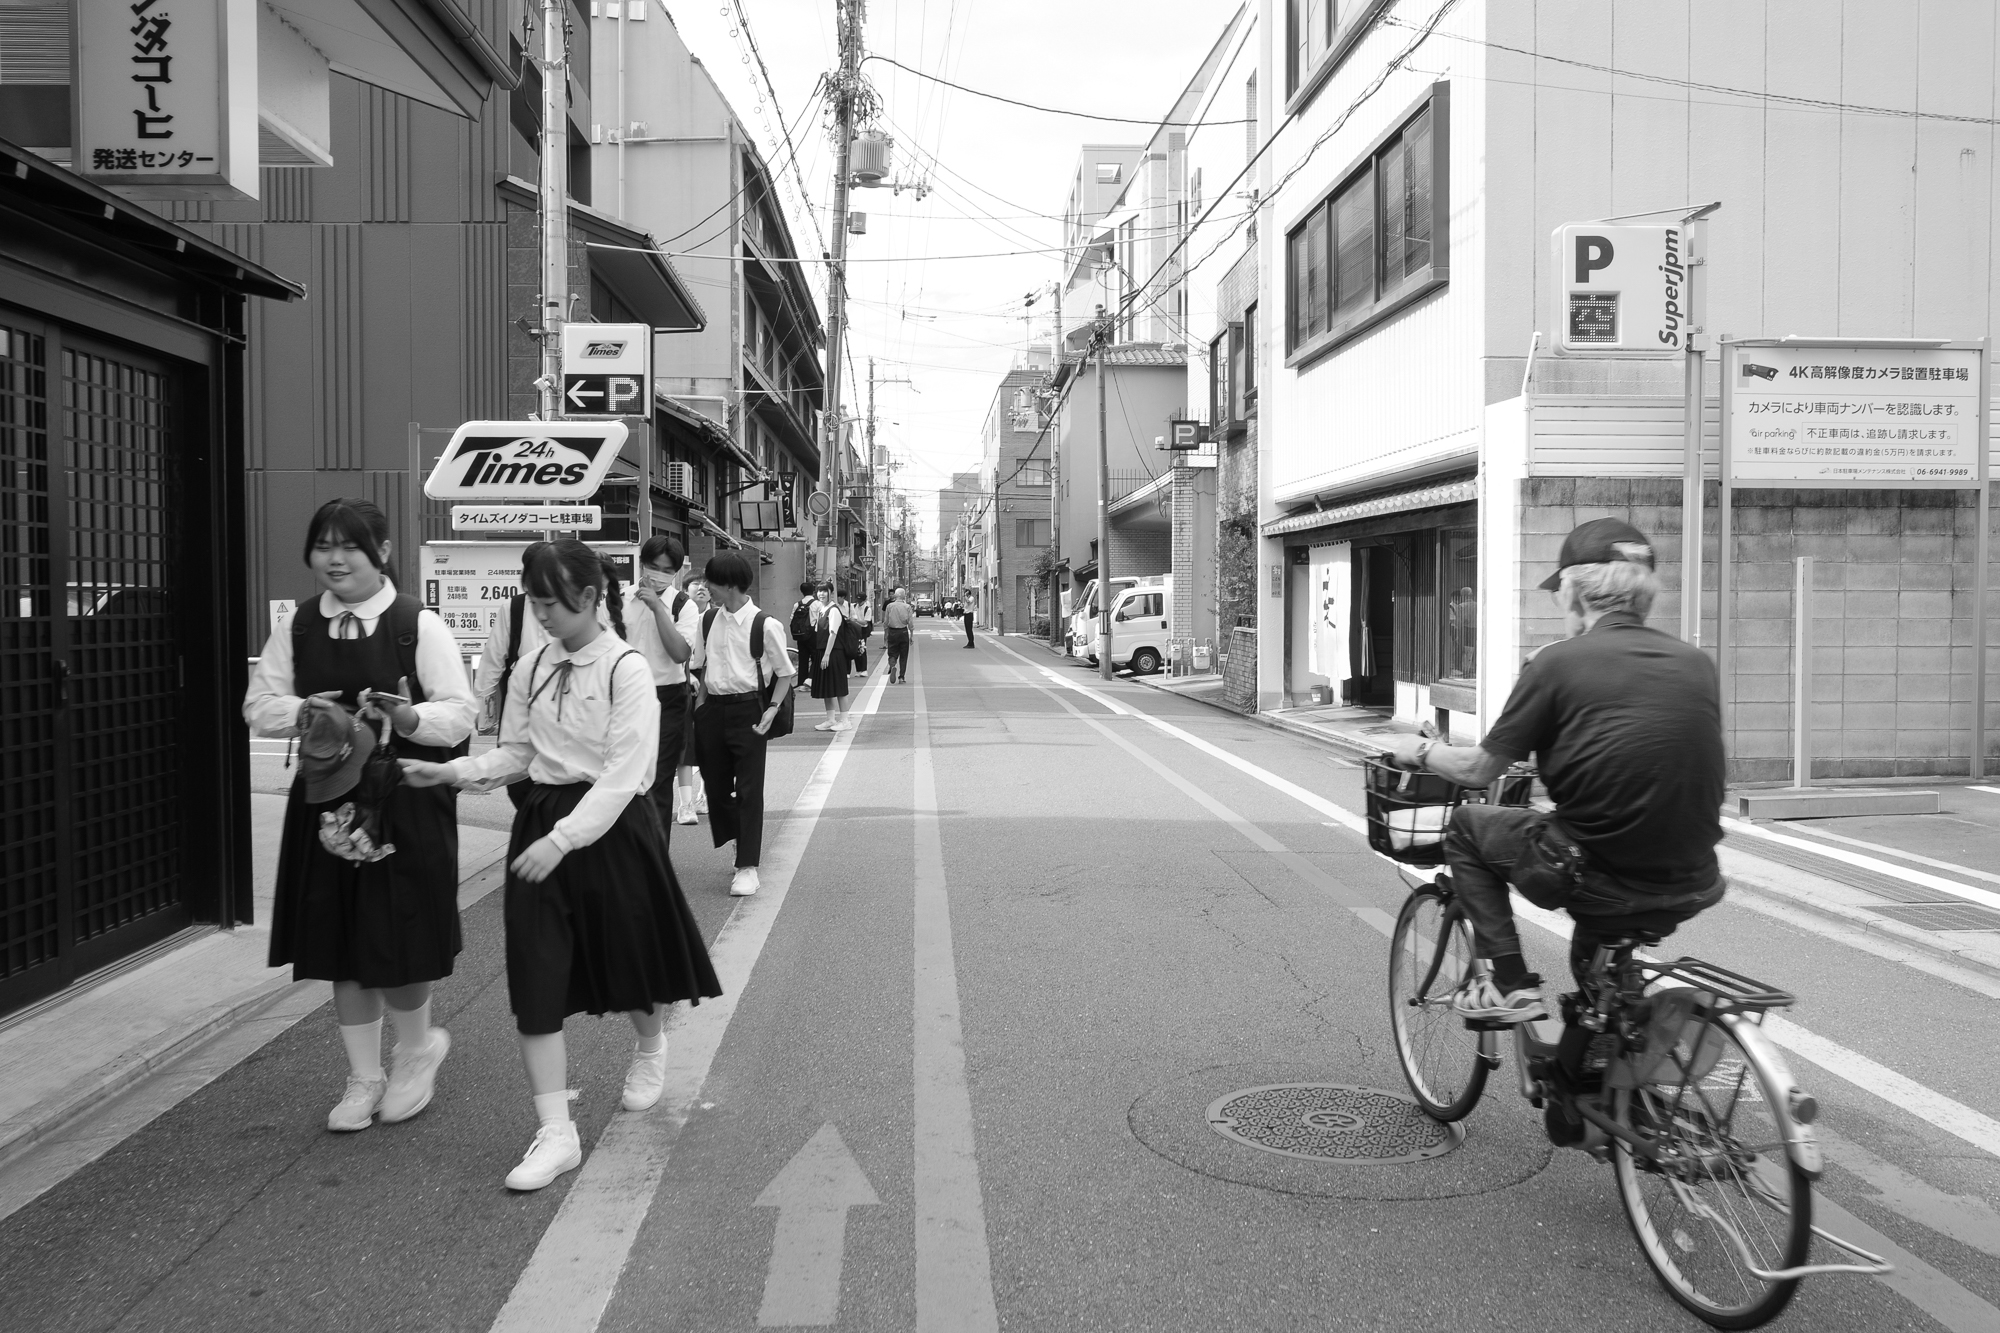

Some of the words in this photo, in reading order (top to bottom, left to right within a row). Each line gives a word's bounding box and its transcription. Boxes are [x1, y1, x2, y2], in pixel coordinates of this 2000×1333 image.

[93, 148, 214, 170] 発送センター
[1575, 235, 1615, 284] P
[1658, 229, 1684, 347] Superjpm
[1569, 294, 1616, 342] 空
[587, 344, 620, 356] Times
[1788, 365, 1969, 382] 4K高解像度カメラ設置駐車場
[608, 377, 639, 412] P
[1748, 401, 1960, 417] カメラにより車両ナンバーを認識します。
[1175, 424, 1196, 445] P
[1806, 427, 1953, 441] 不正車両は、追跡し請求します。
[513, 440, 555, 458] 24h
[456, 446, 592, 488] Times
[1916, 468, 1969, 476] 06-6941-9989
[459, 512, 594, 525] タイムズイノダコーヒ駐車場
[480, 585, 518, 601] 2,640
